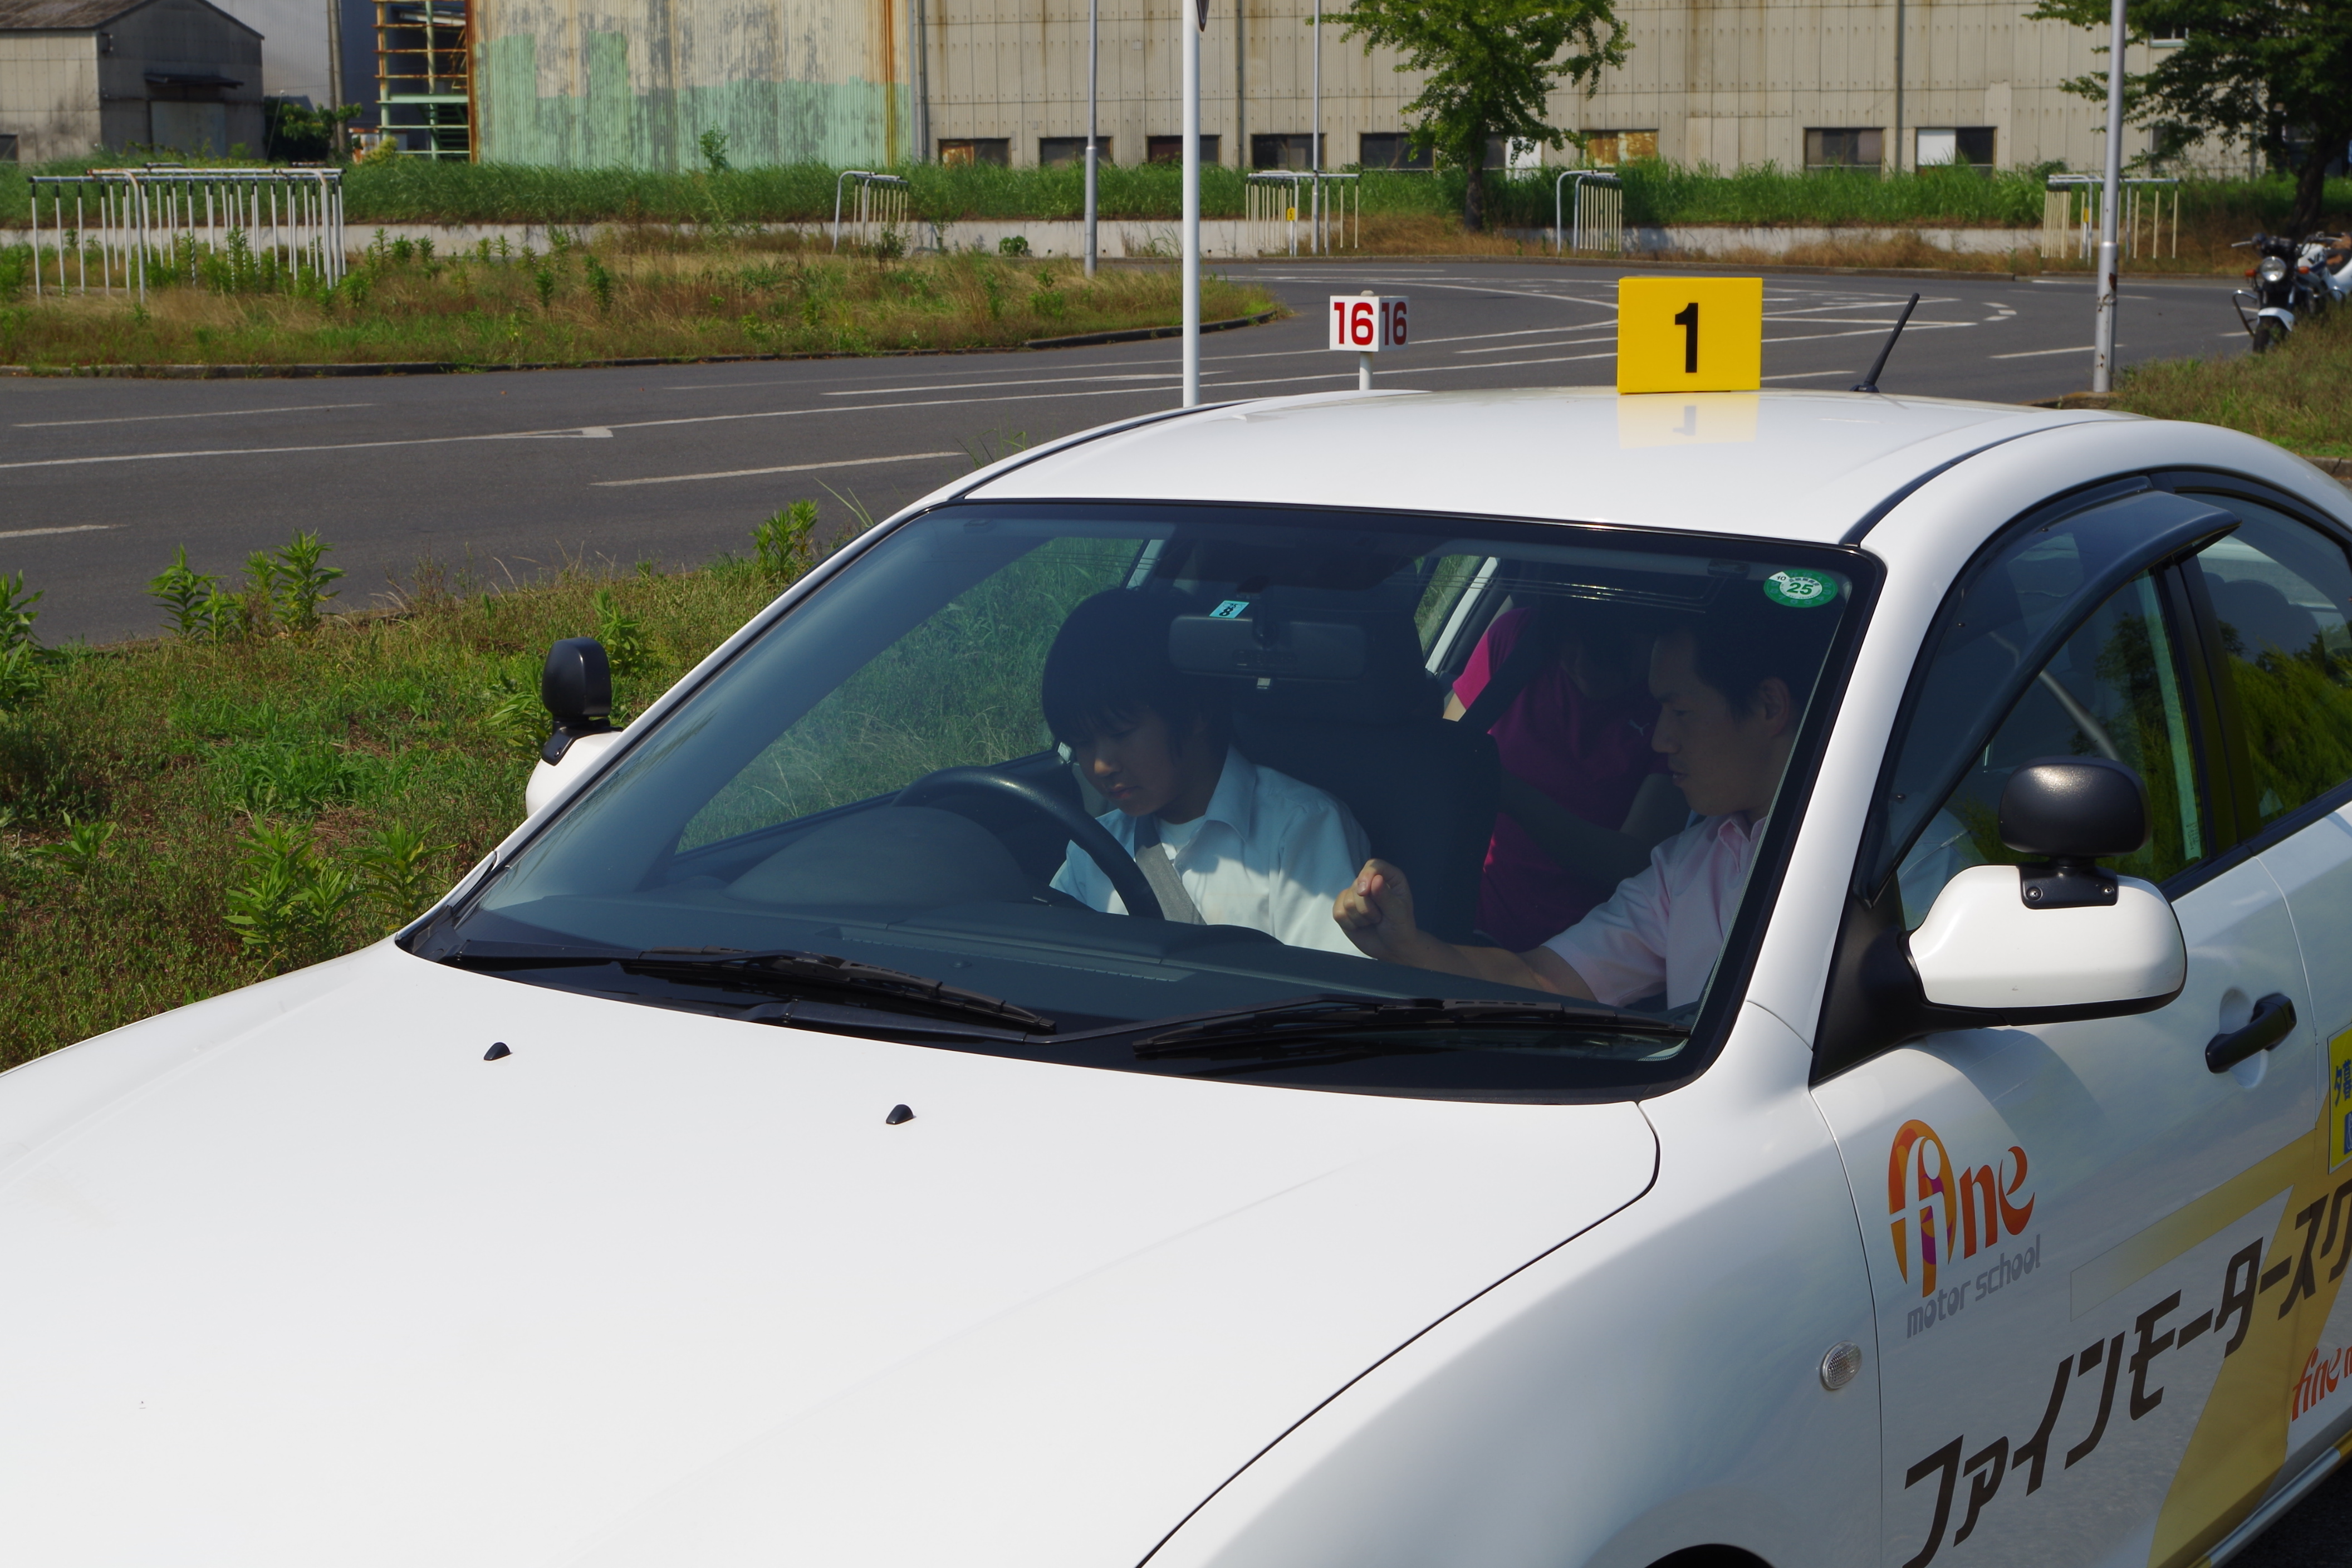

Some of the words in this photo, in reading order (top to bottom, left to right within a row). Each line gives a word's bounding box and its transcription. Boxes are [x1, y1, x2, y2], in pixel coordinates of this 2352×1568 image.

[1334, 302, 1373, 345] 16
[1381, 301, 1407, 345] 16
[1674, 302, 1698, 373] 1
[1787, 582, 1814, 595] 25
[1907, 1280, 1971, 1339] motor
[1975, 1234, 2040, 1302] school
[2292, 1346, 2340, 1422] fine
